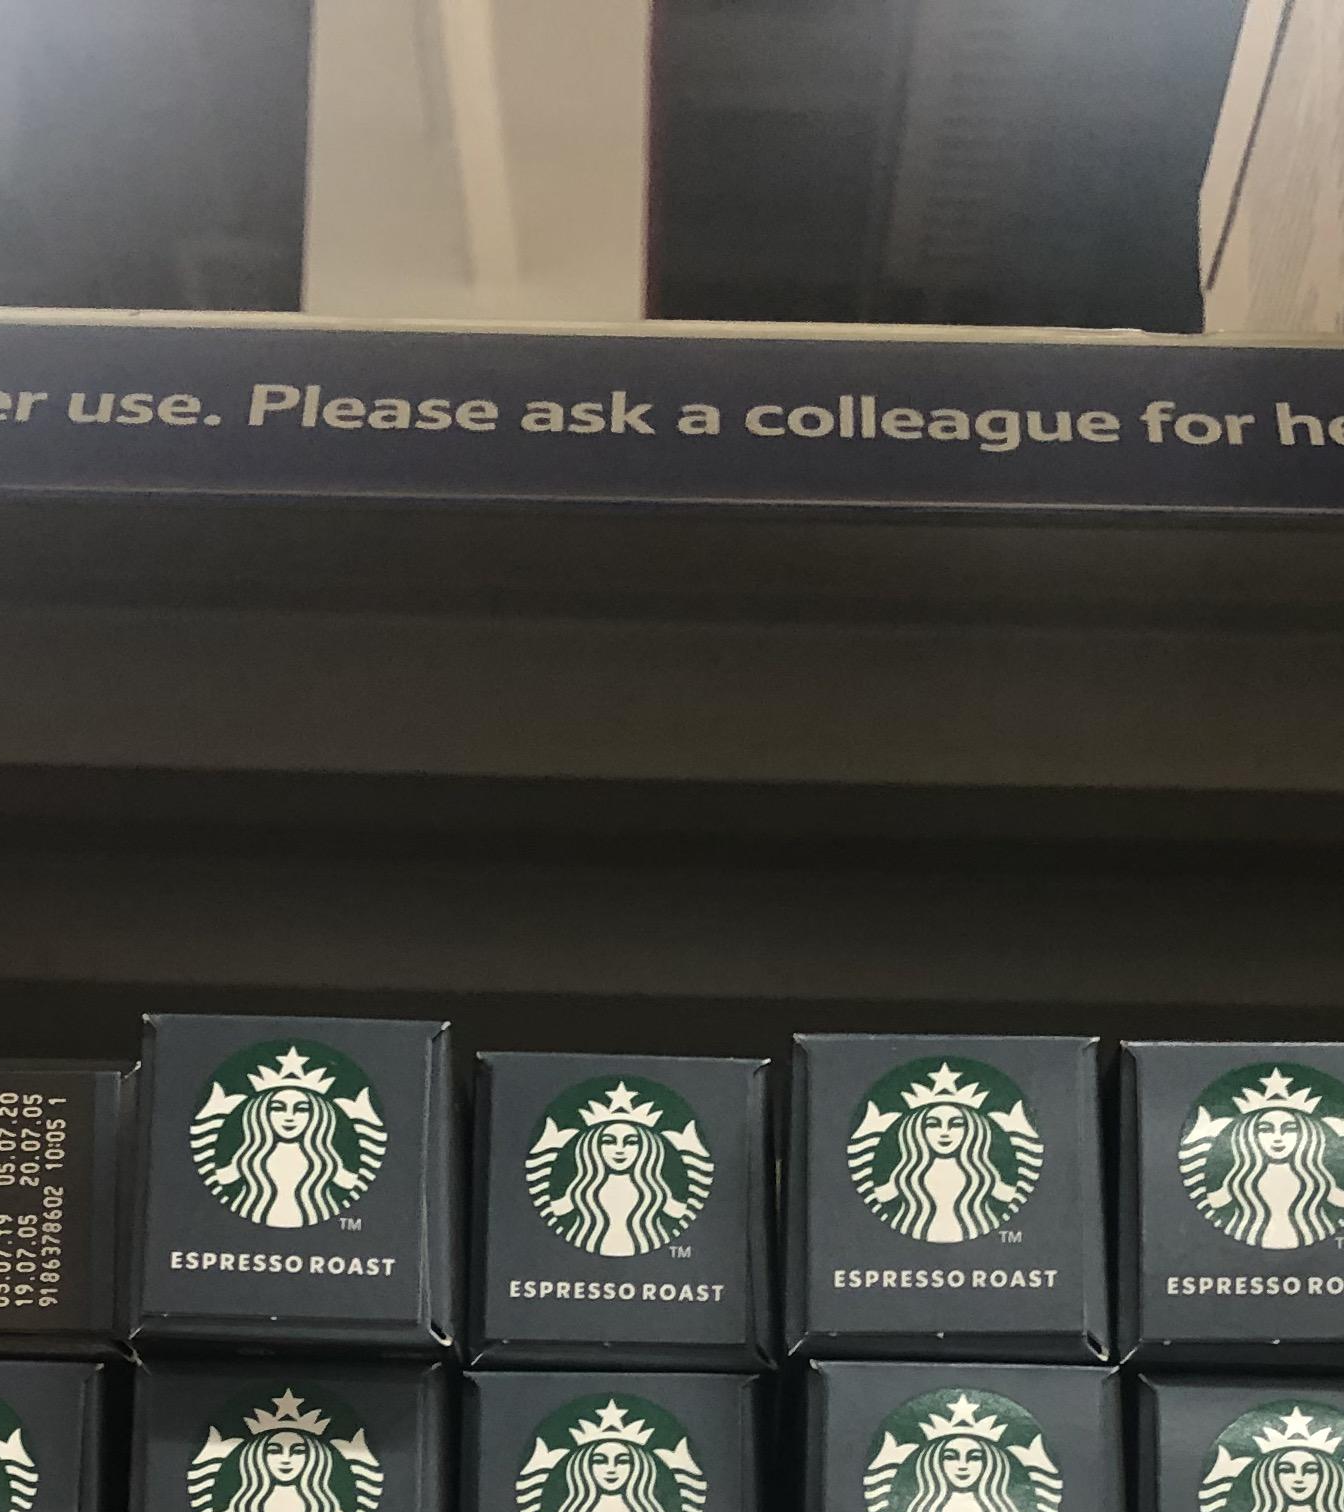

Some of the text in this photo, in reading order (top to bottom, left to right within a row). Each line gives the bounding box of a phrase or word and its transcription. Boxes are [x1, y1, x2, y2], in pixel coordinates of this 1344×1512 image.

[69, 393, 221, 425] use.
[248, 384, 498, 430] Please
[521, 391, 655, 434] ask
[677, 404, 720, 434] a
[745, 395, 1120, 452] colleague
[1140, 401, 1254, 444] for
[20, 1094, 43, 1187] 20.07.05
[39, 1097, 67, 1307] 9186378602 10:05 1
[15, 1214, 38, 1306] 19.07.05
[172, 1252, 395, 1275] ESPRESSO ROAST
[835, 1270, 1057, 1287] ESPRESSO ROAST
[510, 1281, 723, 1301] ESPRESSO ROAST
[1168, 1277, 1301, 1294] ESPRESSO
